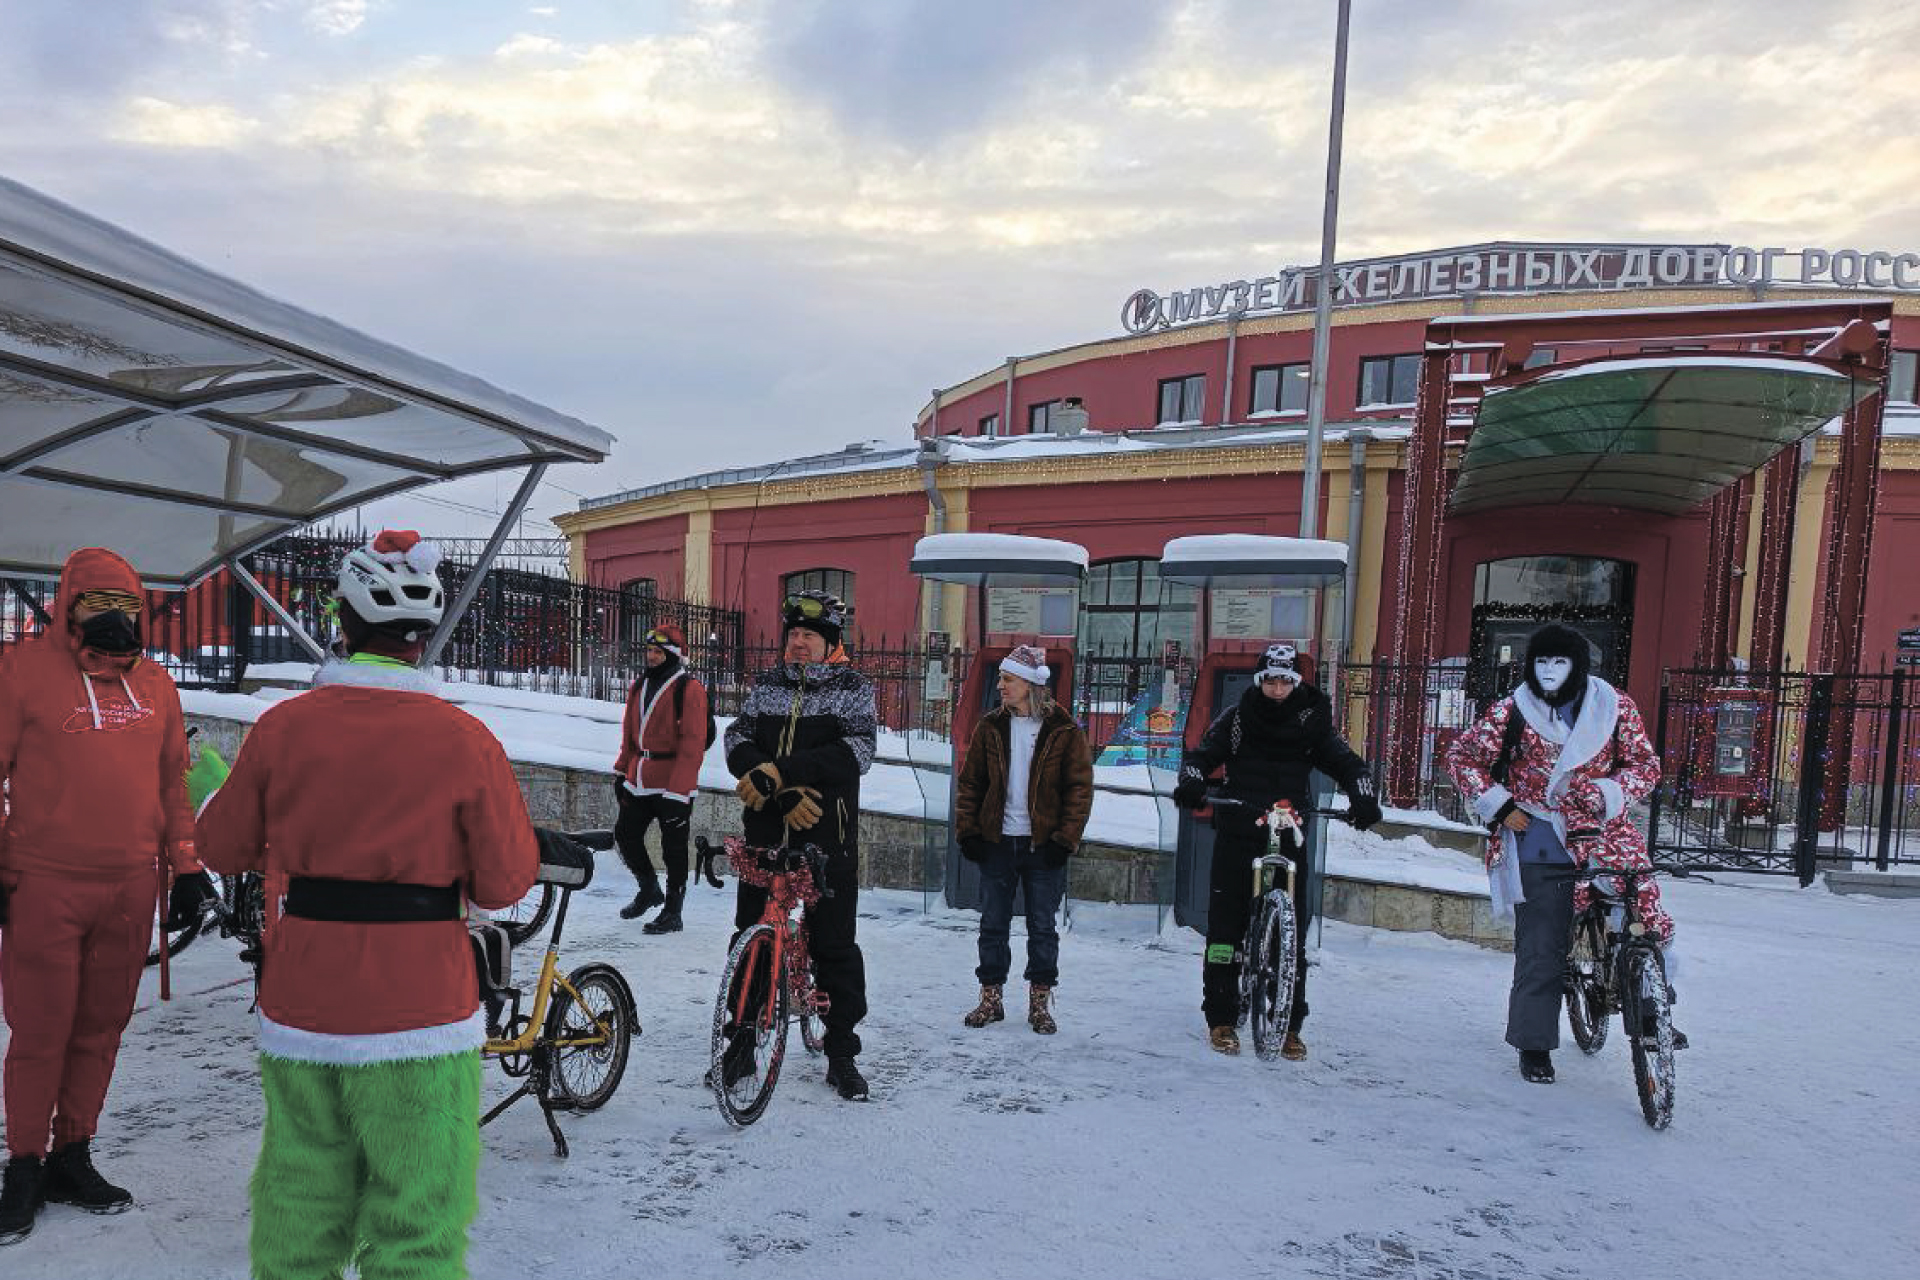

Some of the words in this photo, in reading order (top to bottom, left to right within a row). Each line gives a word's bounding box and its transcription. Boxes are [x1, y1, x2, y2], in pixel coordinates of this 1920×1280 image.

[1169, 265, 1306, 322] МУЗЕЙ
[1329, 249, 1600, 300] ЖЕЛЕЗНЫХ
[1616, 247, 1784, 287] ДОРОГ
